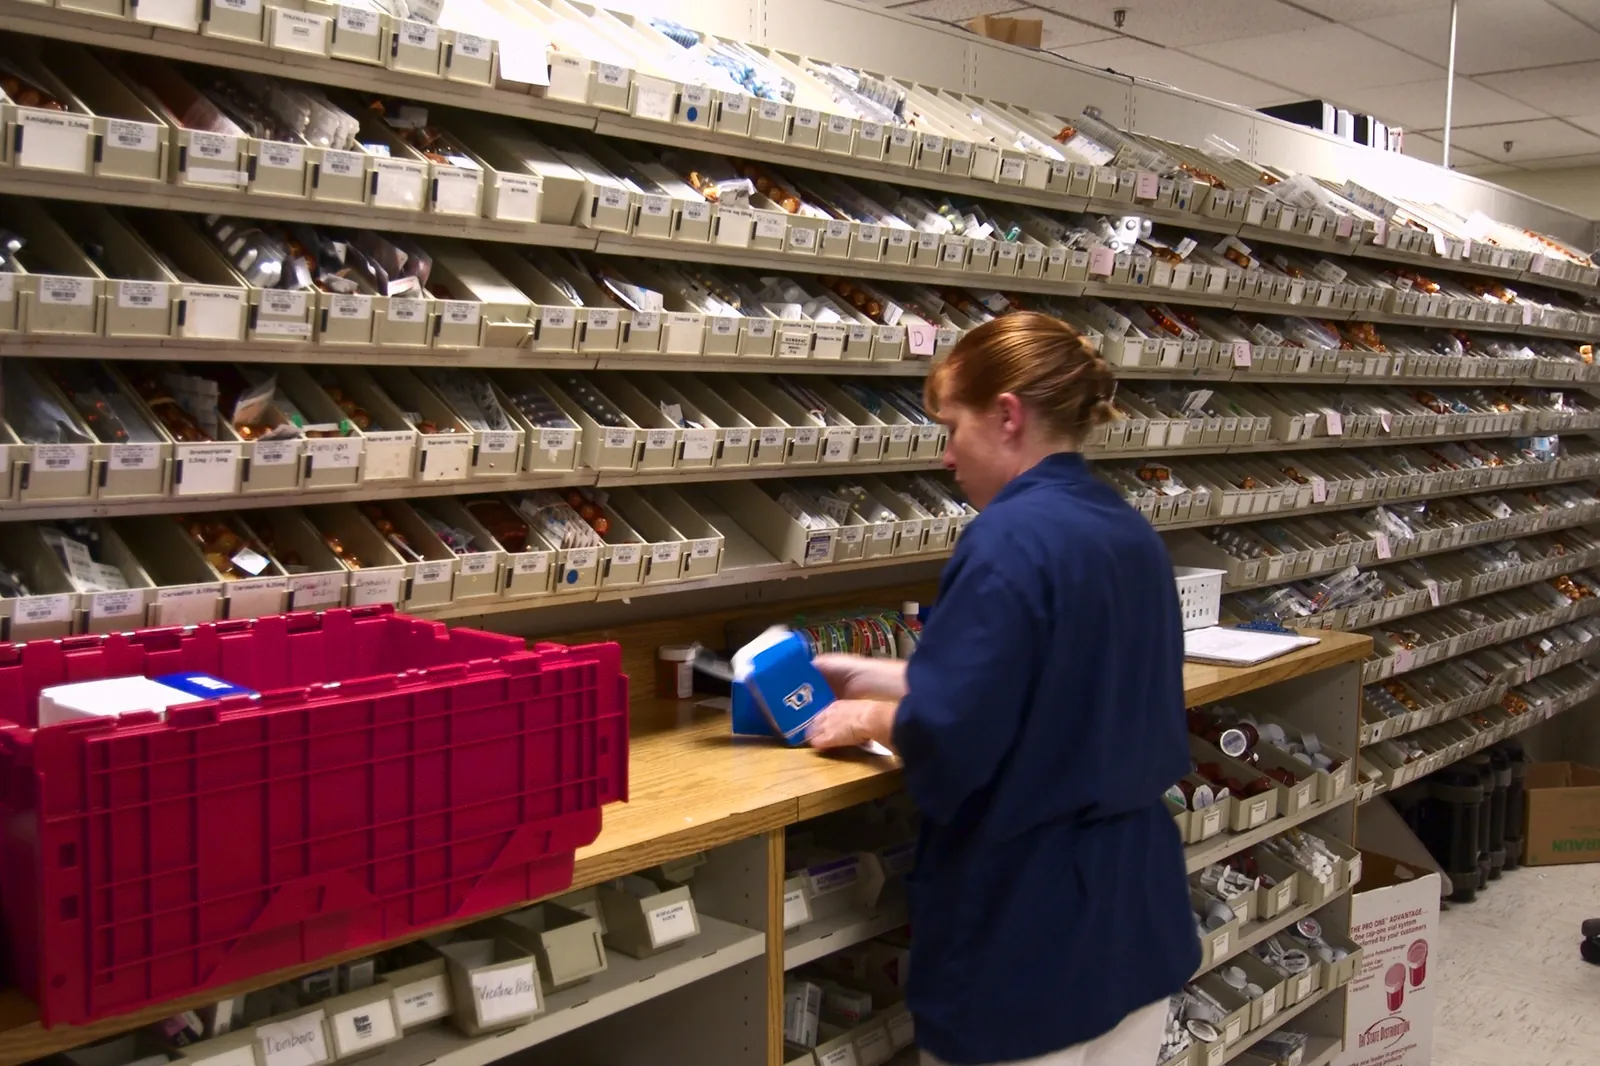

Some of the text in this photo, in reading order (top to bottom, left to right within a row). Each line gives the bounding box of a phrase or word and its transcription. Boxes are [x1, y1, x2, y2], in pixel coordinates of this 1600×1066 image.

[913, 330, 924, 347] D
[1351, 925, 1361, 934] THE
[1362, 922, 1373, 930] PRO
